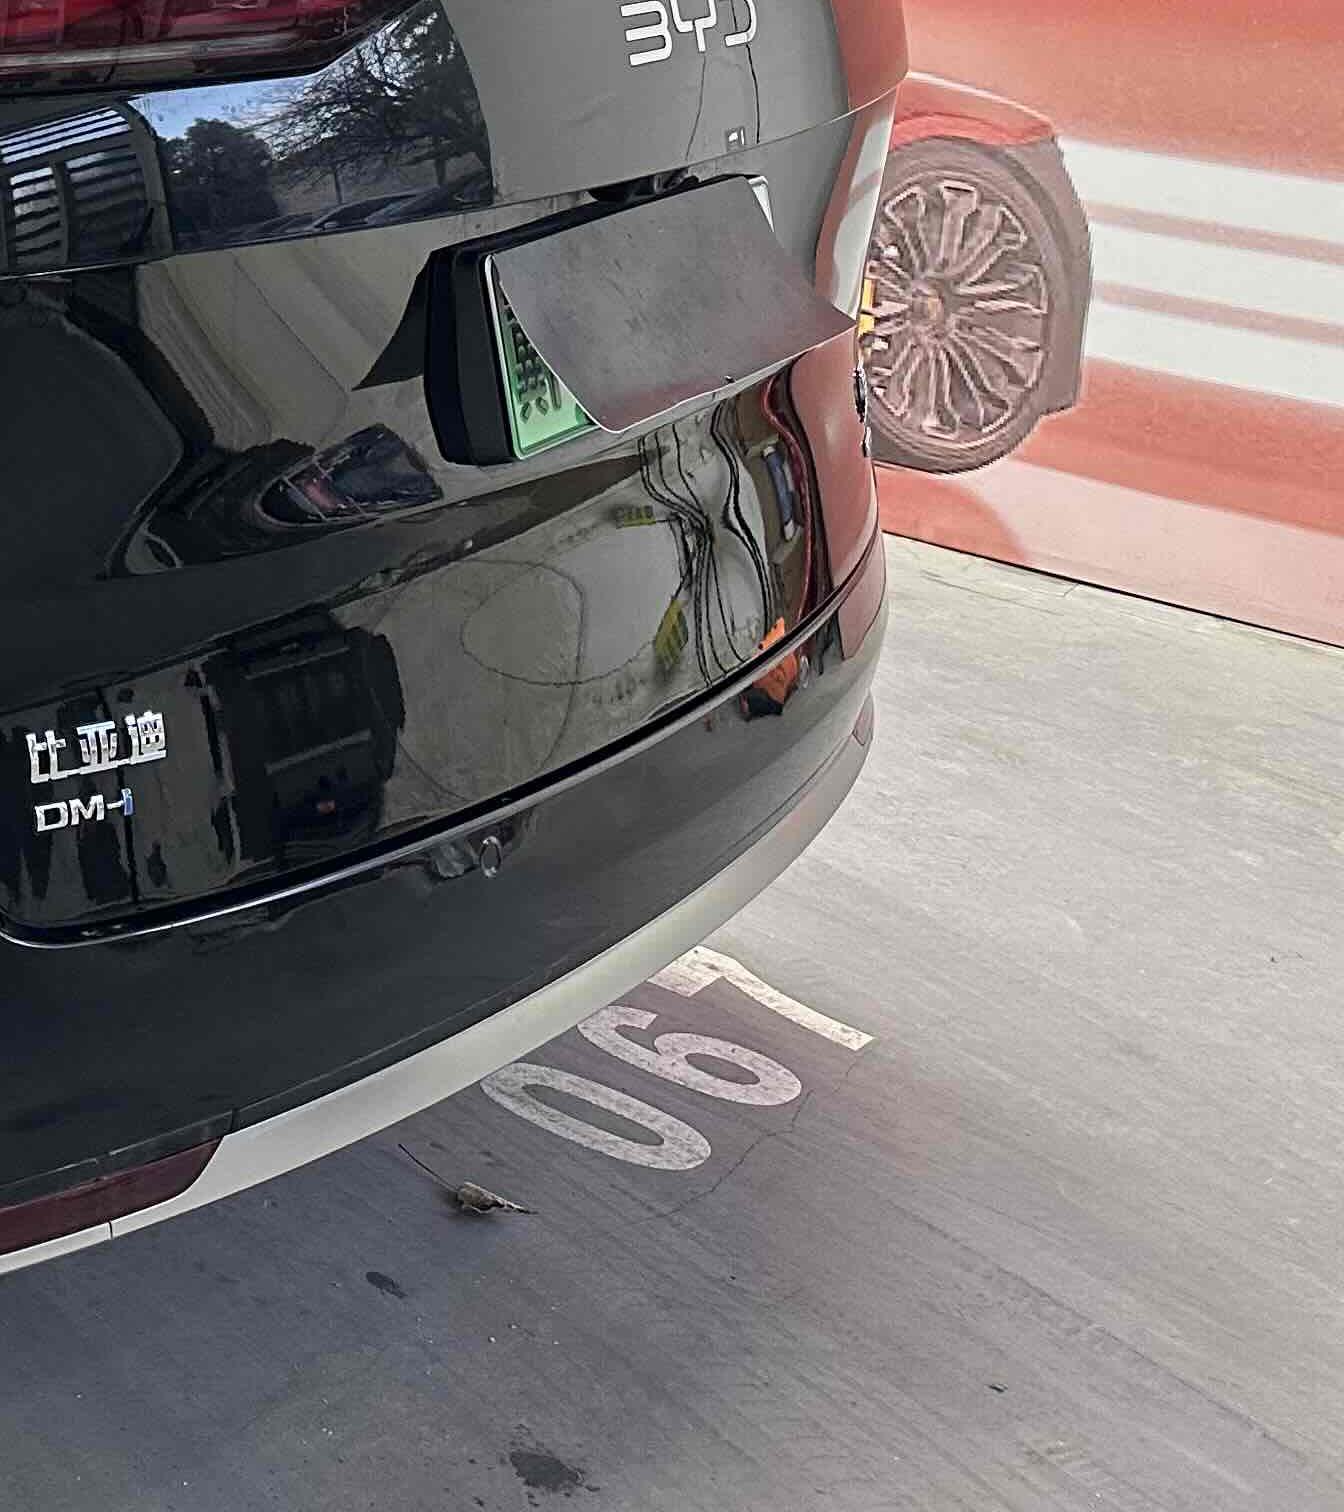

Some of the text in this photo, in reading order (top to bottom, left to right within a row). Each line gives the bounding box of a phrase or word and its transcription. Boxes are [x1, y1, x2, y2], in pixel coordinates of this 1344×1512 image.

[26, 711, 168, 784] 比亚迪
[35, 788, 134, 833] DM-i
[480, 945, 875, 1171] 067
